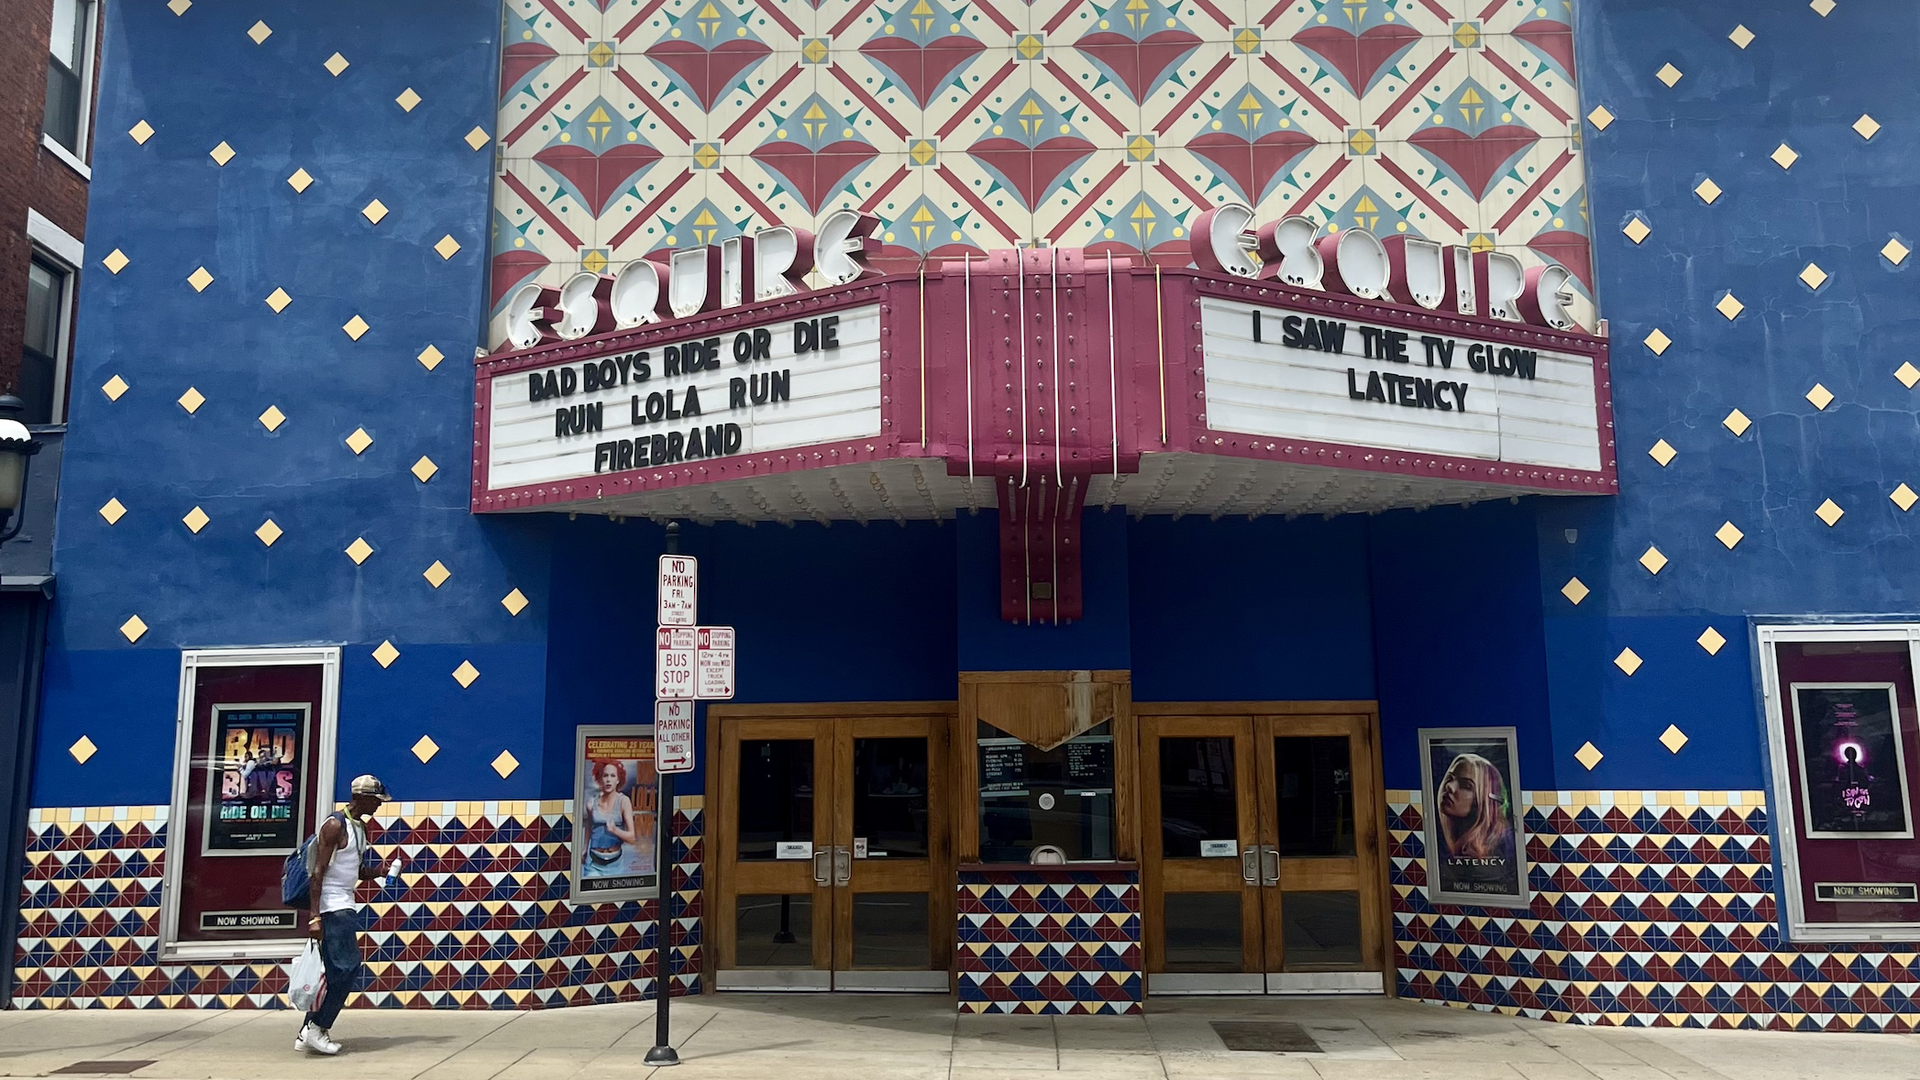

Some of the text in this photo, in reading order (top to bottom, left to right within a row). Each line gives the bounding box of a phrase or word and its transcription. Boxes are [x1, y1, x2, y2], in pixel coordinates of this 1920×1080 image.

[1192, 202, 1575, 330] ESQUIRE
[506, 209, 879, 351] ESQUIRE
[1252, 310, 1537, 380] I SAW THE TV GLOW
[529, 316, 839, 402] BAD BOYS RIDE OR DIE
[1347, 367, 1468, 413] LATENCY
[555, 369, 790, 438] RUN LOLA RUN
[594, 422, 742, 473] FIREBRAND
[671, 560, 686, 574] NO
[662, 574, 694, 589] PARKING
[658, 632, 671, 646] NO
[673, 639, 693, 647] PARKING
[698, 632, 710, 646] NO
[712, 639, 730, 647] PARKING
[666, 653, 687, 667] BUS
[663, 670, 690, 684] STOP
[668, 704, 680, 717] NO
[658, 717, 691, 730] PARKING
[658, 730, 691, 743] ALL OTHER
[223, 728, 297, 765] BAD
[588, 741, 628, 749] CELEBRATING
[665, 744, 684, 754] TIMES
[221, 770, 294, 800] BS
[631, 786, 656, 811] LOLA
[220, 804, 291, 819] RIDE OR DIE
[593, 878, 644, 889] NOW SHOWING
[1454, 882, 1507, 892] NOW SHOWING
[1833, 886, 1900, 896] NOW SHOWING
[217, 915, 280, 926] NOW SHOWING
